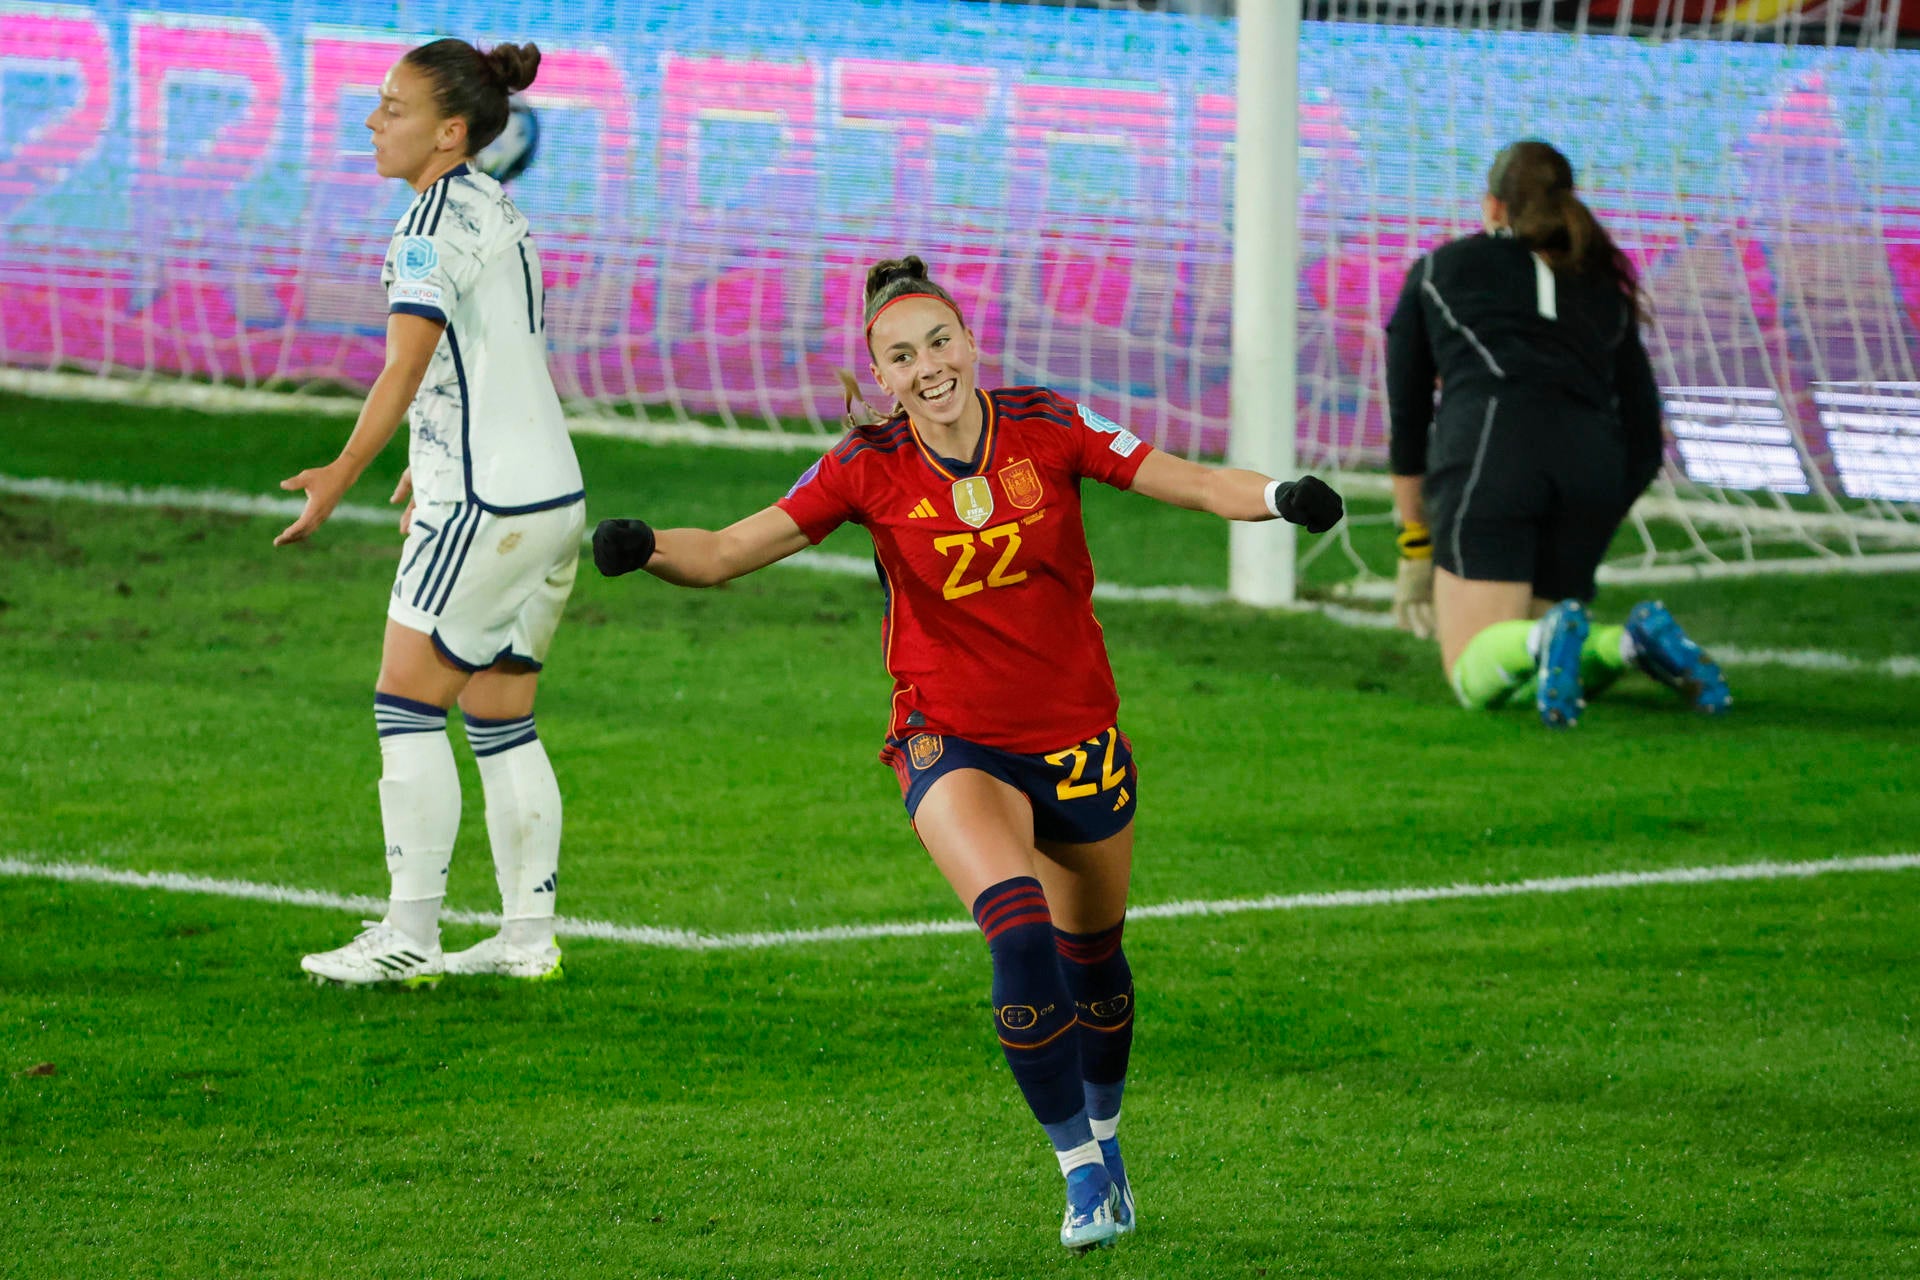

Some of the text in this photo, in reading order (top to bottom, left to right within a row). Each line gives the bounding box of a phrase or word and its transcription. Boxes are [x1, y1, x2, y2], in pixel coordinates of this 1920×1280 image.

[1529, 251, 1558, 320] 1
[402, 519, 439, 577] 7
[933, 522, 1028, 600] 22
[1044, 727, 1126, 800] 22
